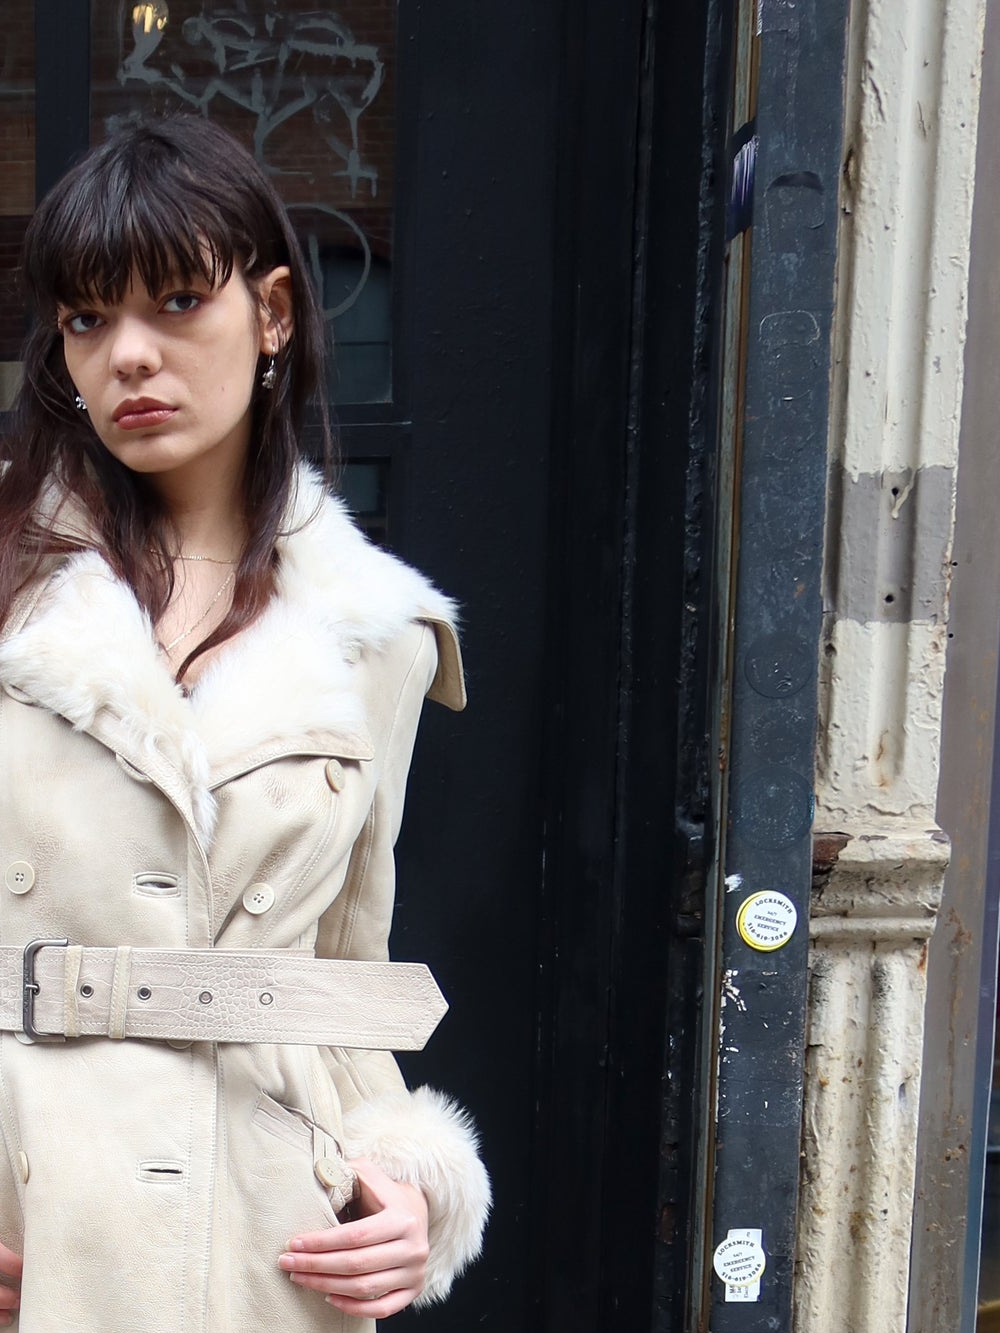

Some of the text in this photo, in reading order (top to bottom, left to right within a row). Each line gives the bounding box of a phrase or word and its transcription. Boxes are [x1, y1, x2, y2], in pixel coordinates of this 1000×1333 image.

[755, 898, 794, 915] LOCKSMITH
[754, 914, 787, 926] EMERGENCY
[757, 923, 780, 932] SERVICE
[717, 1240, 755, 1256] LOCKSMITH
[723, 1255, 756, 1267] EMERGENCY
[730, 1263, 753, 1273] SERVICE
